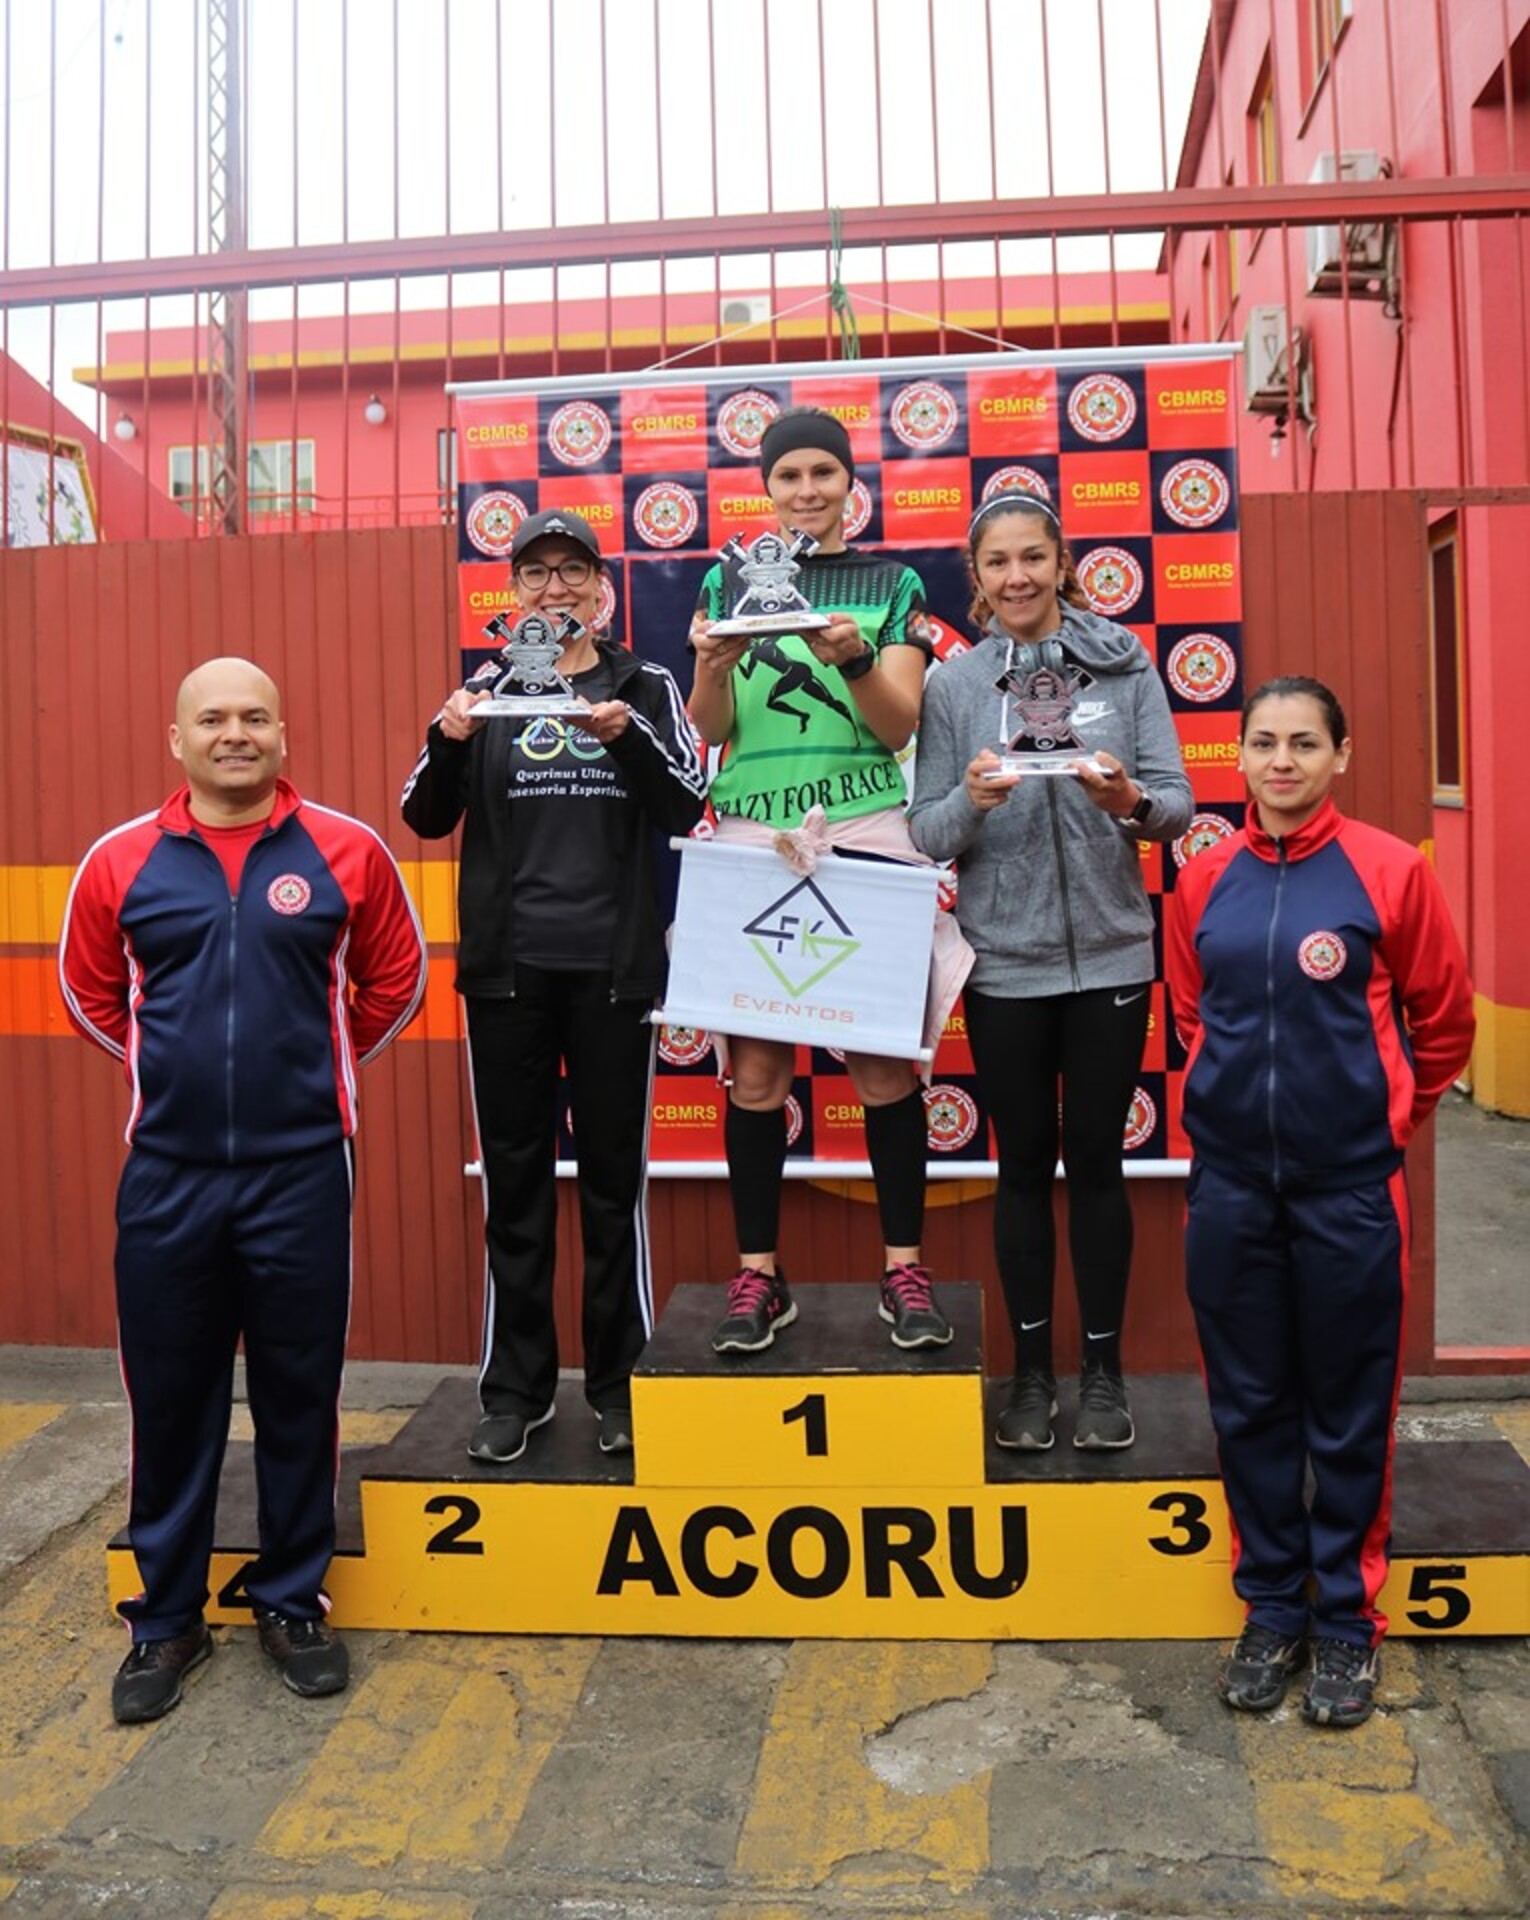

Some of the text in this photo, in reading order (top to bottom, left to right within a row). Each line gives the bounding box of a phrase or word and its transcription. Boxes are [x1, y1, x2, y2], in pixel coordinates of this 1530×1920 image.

[979, 397, 1047, 415] CBMRS
[1158, 389, 1227, 408] CBMRS
[466, 424, 529, 441] CBMRS
[632, 415, 697, 433] CBMRS
[894, 488, 962, 507] CBMRS
[1071, 481, 1141, 500] CBMRS
[719, 496, 774, 515] CBMR
[1165, 563, 1234, 581] CBMRS
[1180, 743, 1239, 760] BMRS
[581, 767, 616, 780] Ultra
[783, 779, 834, 819] FOR
[839, 760, 899, 803] RACE
[653, 1104, 718, 1120] CBMRS
[824, 1104, 865, 1121] CBM
[782, 1393, 829, 1457] 1
[423, 1494, 485, 1556] 2
[1147, 1491, 1213, 1556] 3
[596, 1504, 1030, 1600] ACORU
[1405, 1564, 1472, 1630] 5
